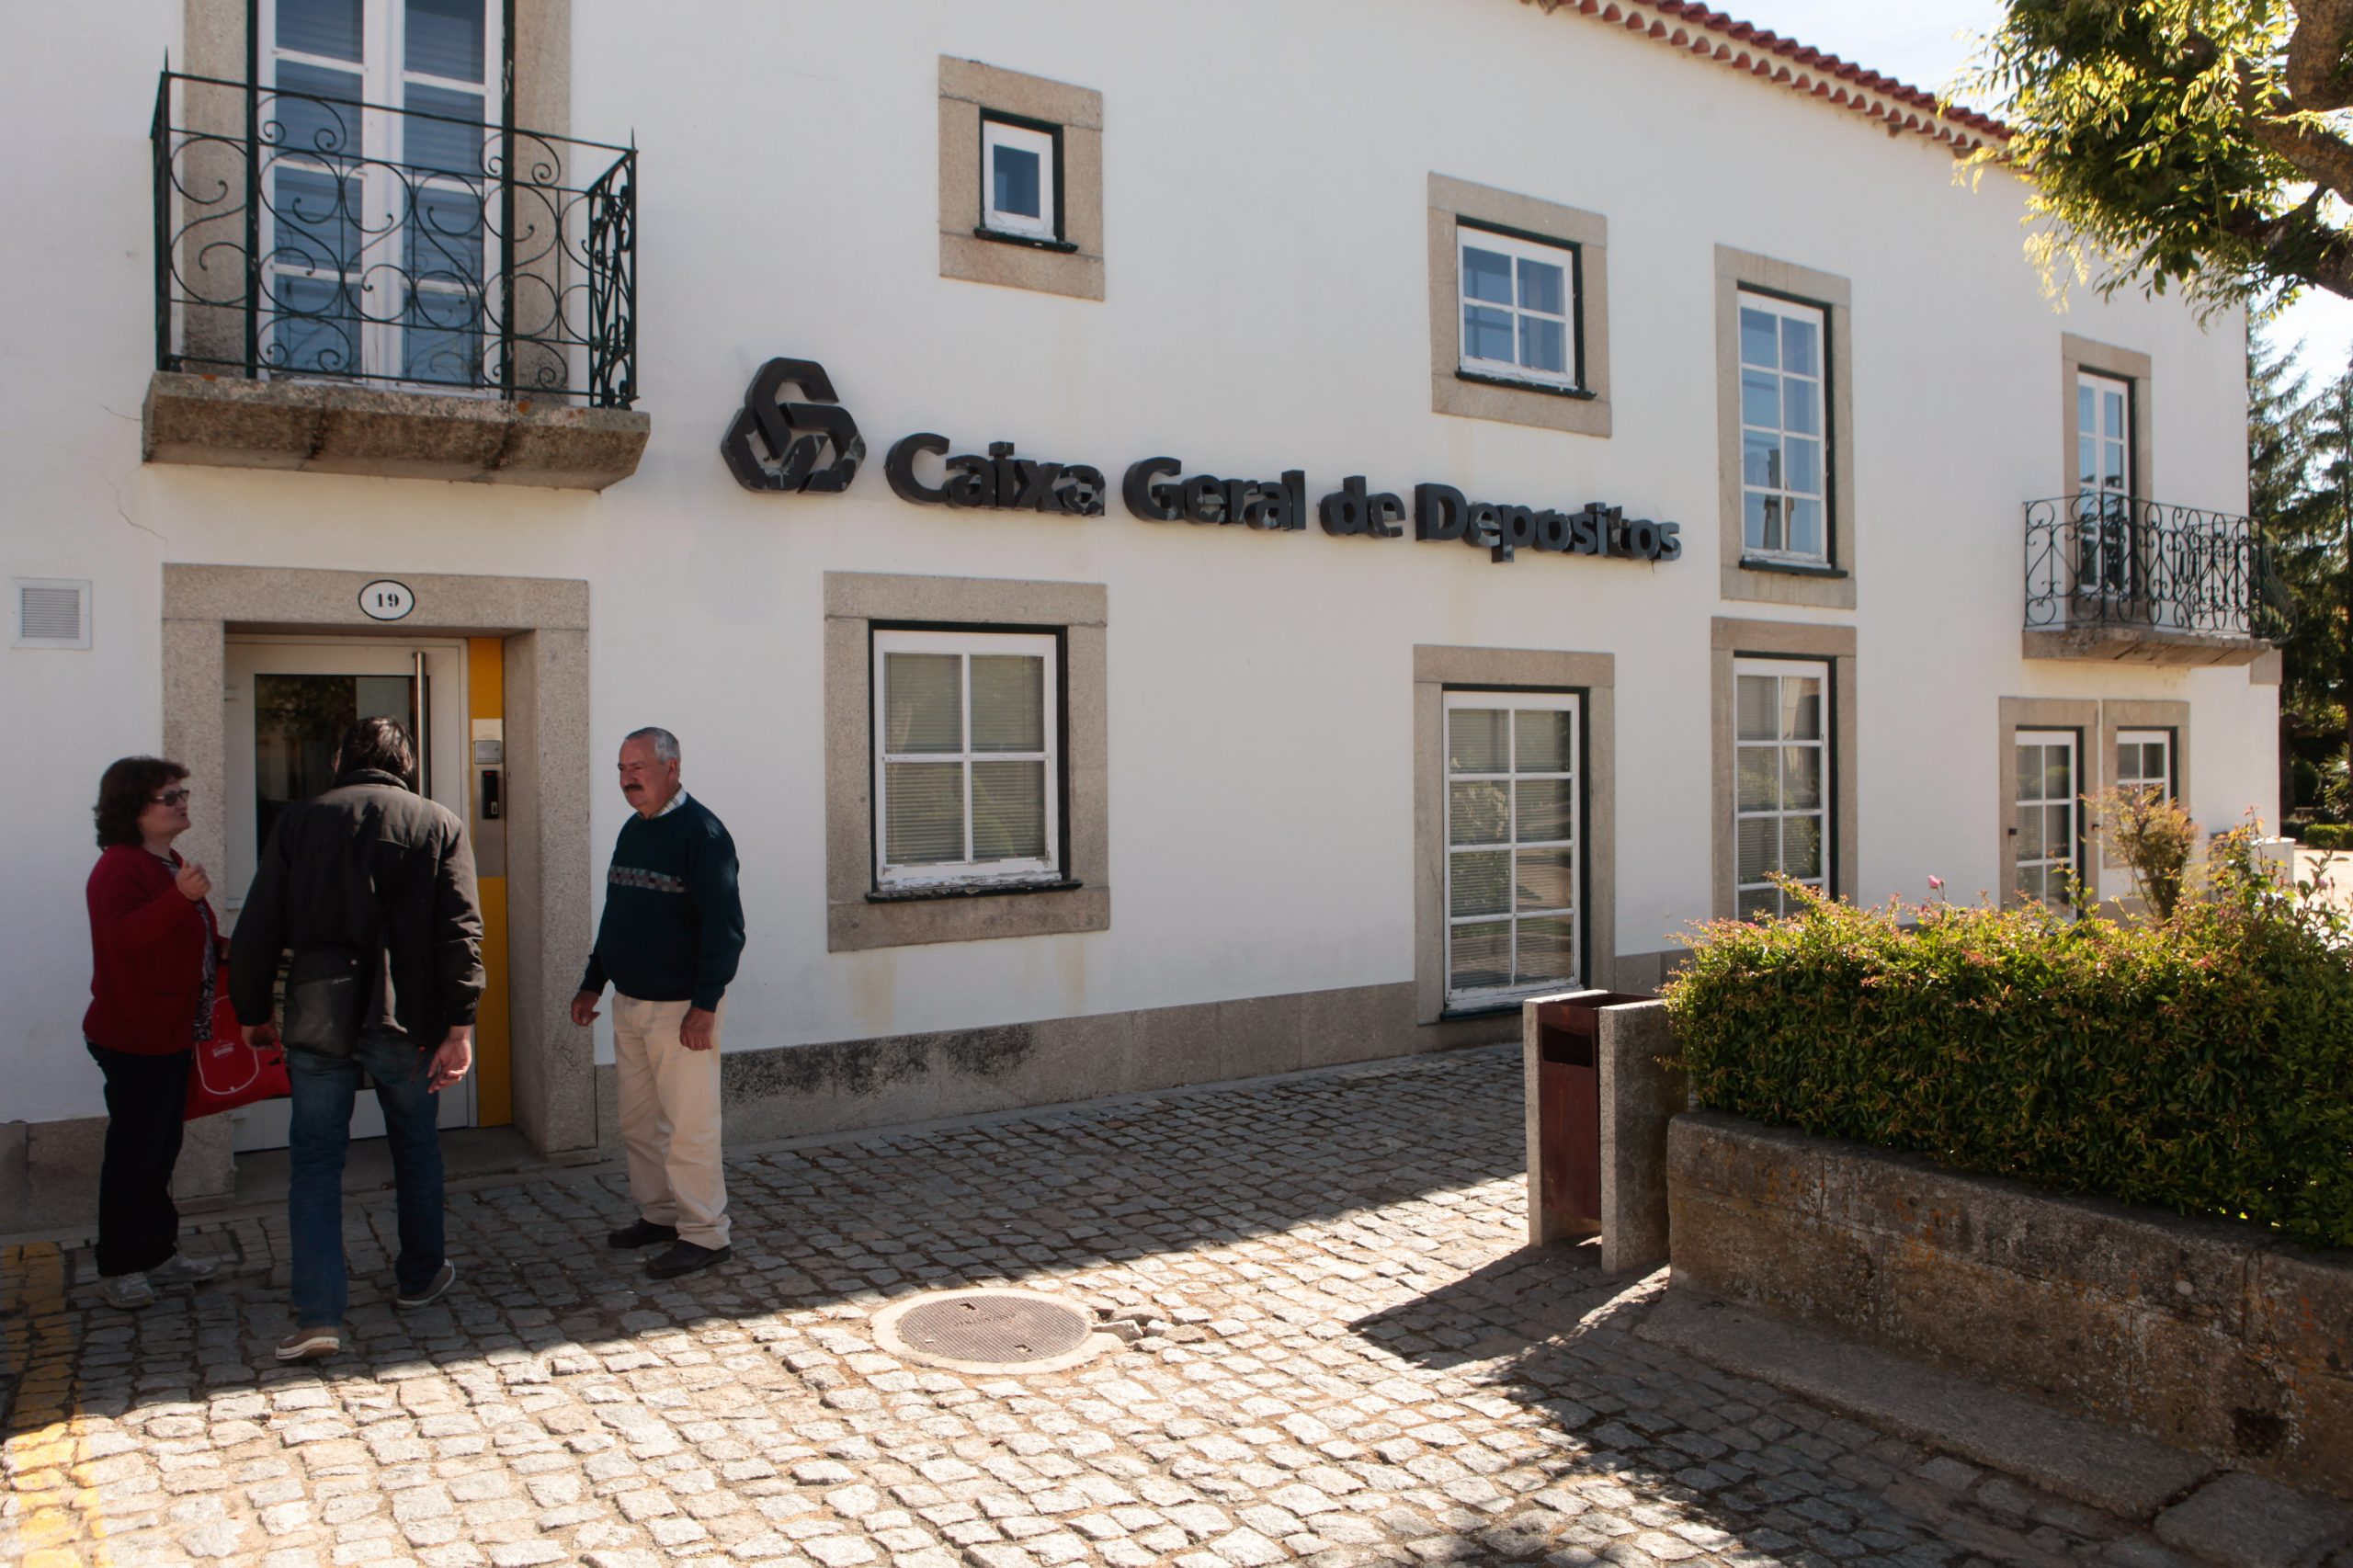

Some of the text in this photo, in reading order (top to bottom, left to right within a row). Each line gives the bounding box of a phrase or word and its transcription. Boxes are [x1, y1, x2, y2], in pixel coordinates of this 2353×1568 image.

[884, 432, 1682, 562] Caixa Geral de Depositos
[378, 593, 400, 608] 19
